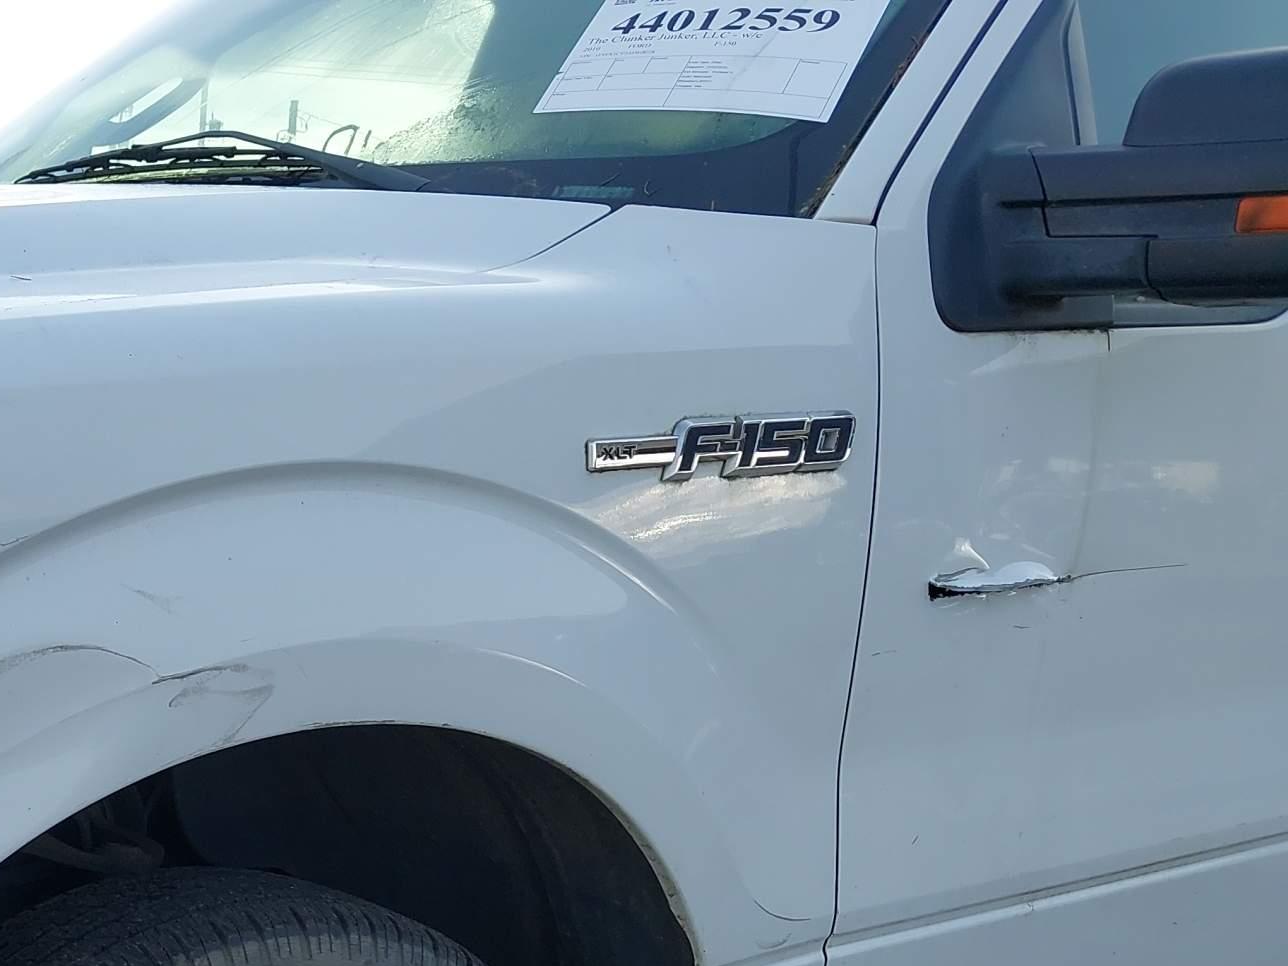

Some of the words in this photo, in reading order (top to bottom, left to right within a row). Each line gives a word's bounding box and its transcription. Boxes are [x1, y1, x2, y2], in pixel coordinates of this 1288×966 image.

[611, 7, 841, 35] 44012559
[588, 37, 608, 45] The
[656, 32, 699, 43] Junker,
[702, 31, 729, 40] LLC
[600, 445, 638, 461] XLT
[664, 411, 855, 481] F-150
